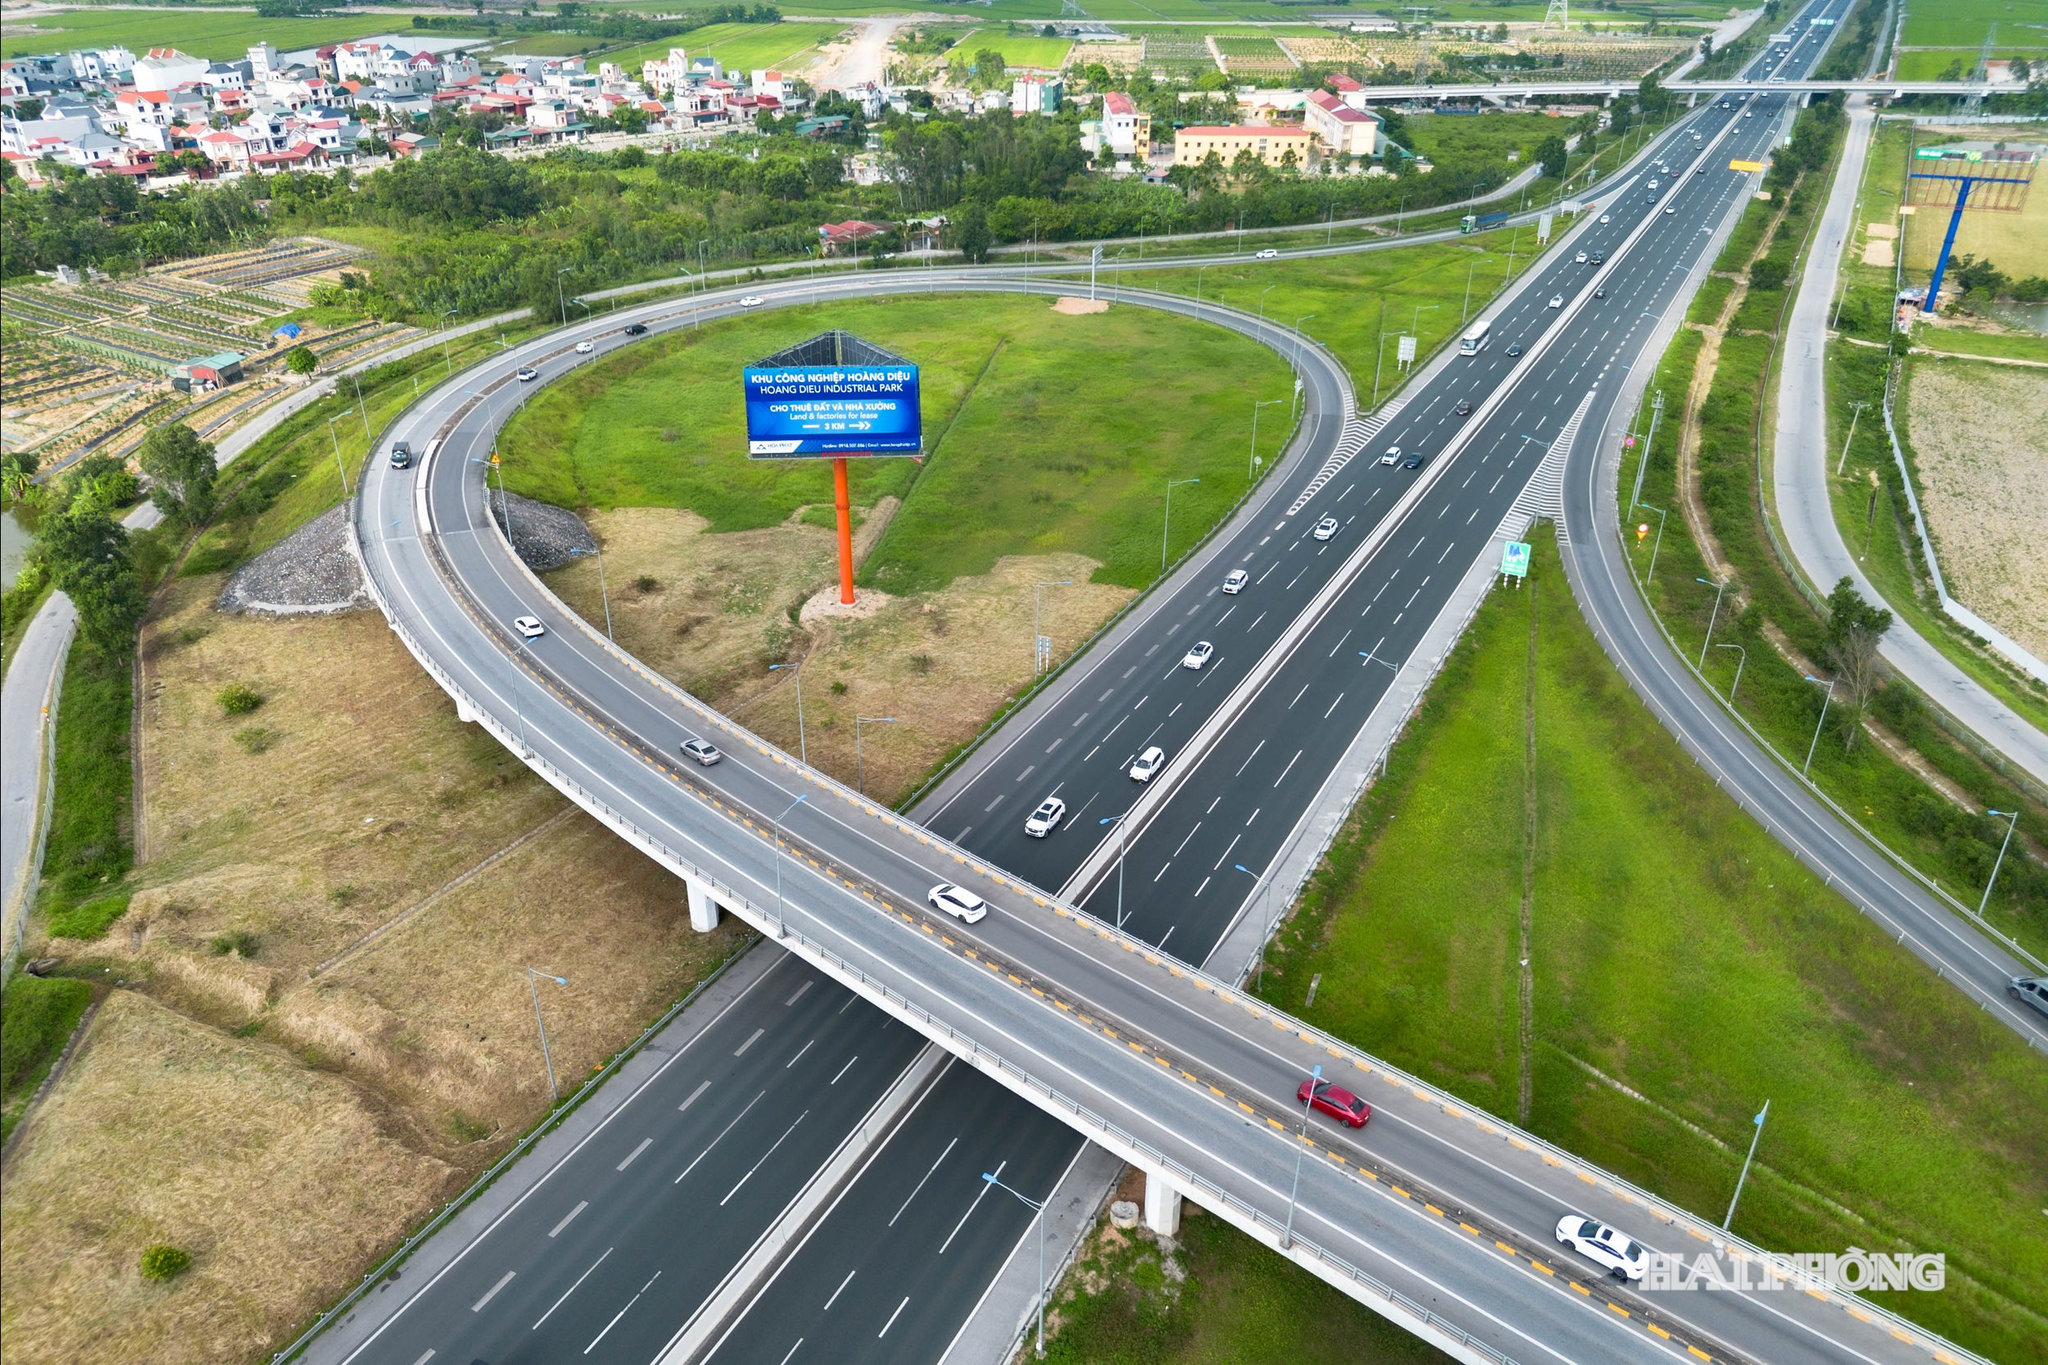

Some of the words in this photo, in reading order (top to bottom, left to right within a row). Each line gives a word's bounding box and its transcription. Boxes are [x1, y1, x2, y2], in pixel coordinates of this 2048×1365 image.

[751, 374, 773, 384] KHU
[775, 373, 805, 383] CÔNG
[808, 371, 845, 384] NGHIỆP
[848, 371, 885, 382] HOÀNG
[887, 370, 910, 383] DIỆU
[760, 386, 797, 395] HOANG
[799, 385, 821, 394] DIEU
[824, 384, 878, 393] INDUSTRIAL
[880, 383, 903, 392] PARK
[790, 403, 812, 412] THUÊ
[813, 402, 830, 412] ĐẤT
[832, 402, 844, 411] VÀ
[845, 402, 864, 411] NHÀ
[816, 412, 847, 420] factories
[860, 411, 878, 419] lease
[832, 422, 845, 430] KM
